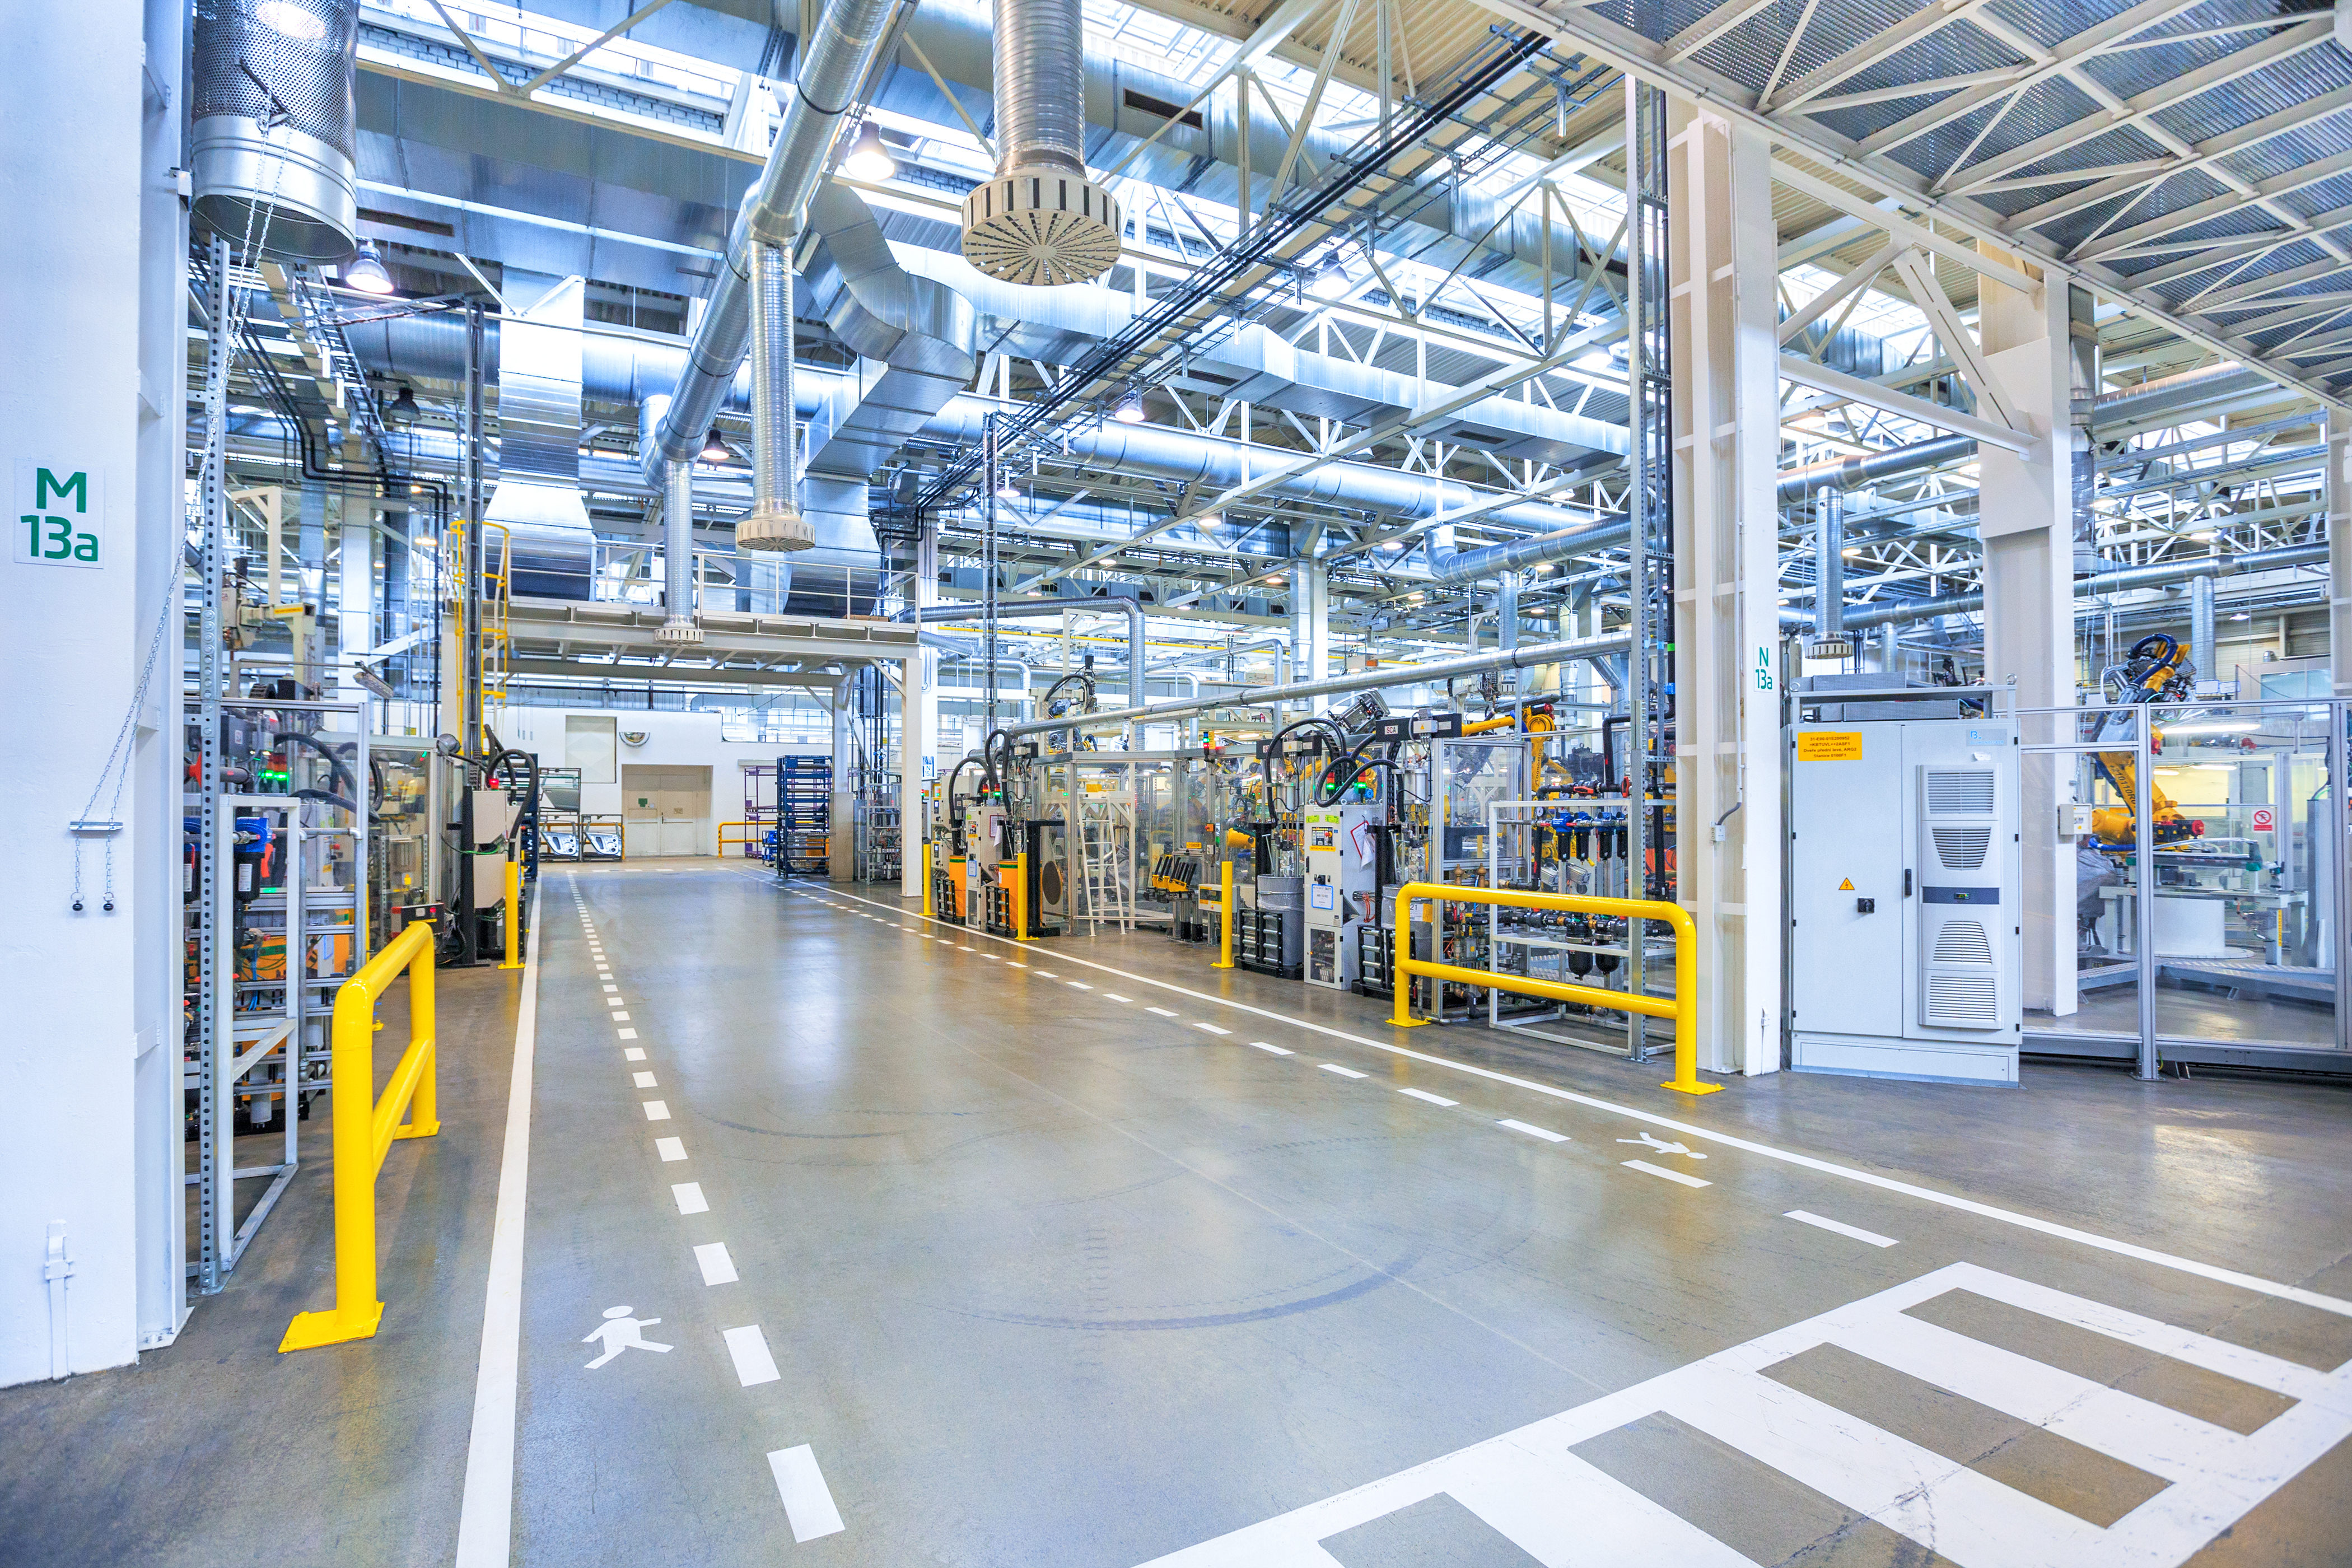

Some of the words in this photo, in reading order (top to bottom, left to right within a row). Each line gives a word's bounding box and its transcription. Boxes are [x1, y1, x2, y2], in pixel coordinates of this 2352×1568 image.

[36, 467, 87, 513] M
[20, 515, 99, 562] 13a
[1760, 647, 1768, 666] N
[1755, 669, 1772, 689] 13a
